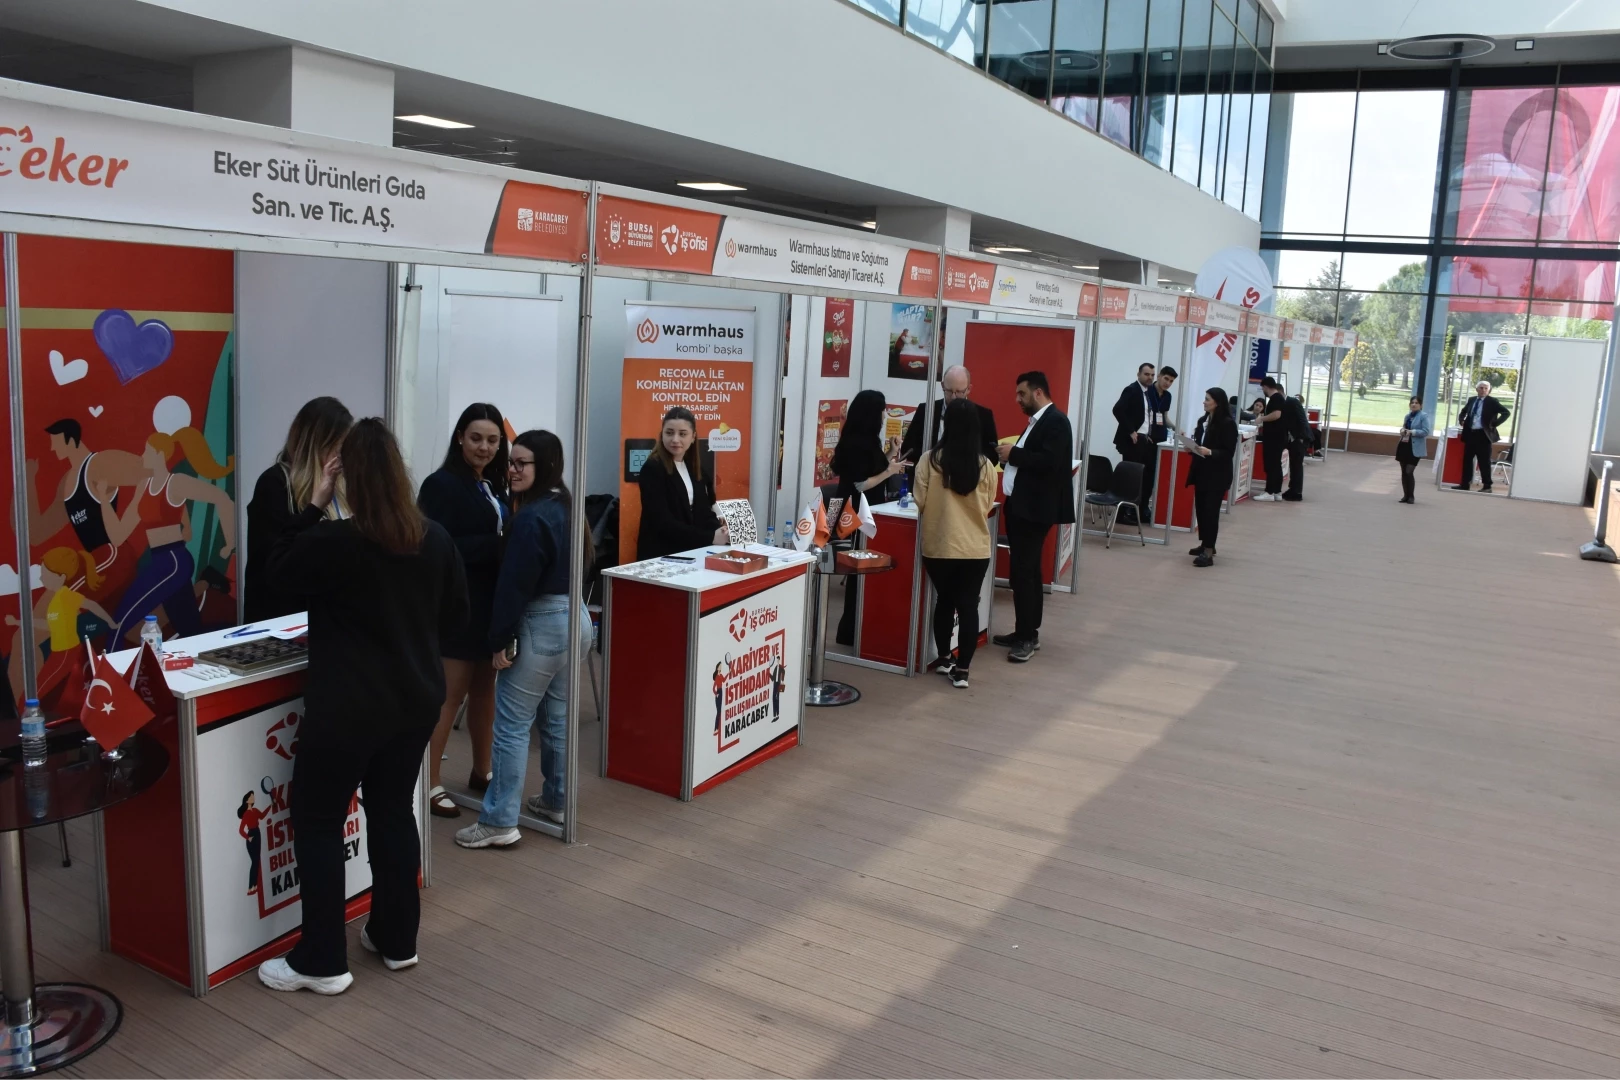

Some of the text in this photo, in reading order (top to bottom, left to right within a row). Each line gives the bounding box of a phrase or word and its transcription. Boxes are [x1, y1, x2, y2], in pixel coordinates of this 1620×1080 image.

[20, 137, 128, 188] eker
[214, 150, 425, 200] Eker Süt Ürünleri Gıda
[252, 192, 394, 232] San. ve Tic. A.Ş.
[534, 211, 568, 224] KARACABEY
[534, 222, 568, 234] BELEDİYESİ
[628, 222, 653, 234] BURSA
[738, 244, 777, 257] warmhaus
[790, 238, 830, 257] Warmhaus
[852, 252, 860, 262] ve
[861, 250, 888, 266] Soğutma
[790, 260, 827, 277] Sistemleri
[828, 265, 850, 282] Sanayi
[852, 268, 873, 283] Ticaret
[662, 324, 744, 339] warmhaus
[714, 344, 742, 355] başka
[660, 368, 724, 379] RECOWA İLE
[636, 379, 744, 391] KOMBİNİZİ UZAKTAN
[652, 391, 730, 403] KONTROL EDİN
[704, 412, 720, 421] EDİN
[729, 643, 779, 680] KARİYER VE
[725, 668, 770, 706] İSTİHDAM
[725, 689, 770, 721] BULUŞMALARI
[725, 704, 769, 738] KARACABEY
